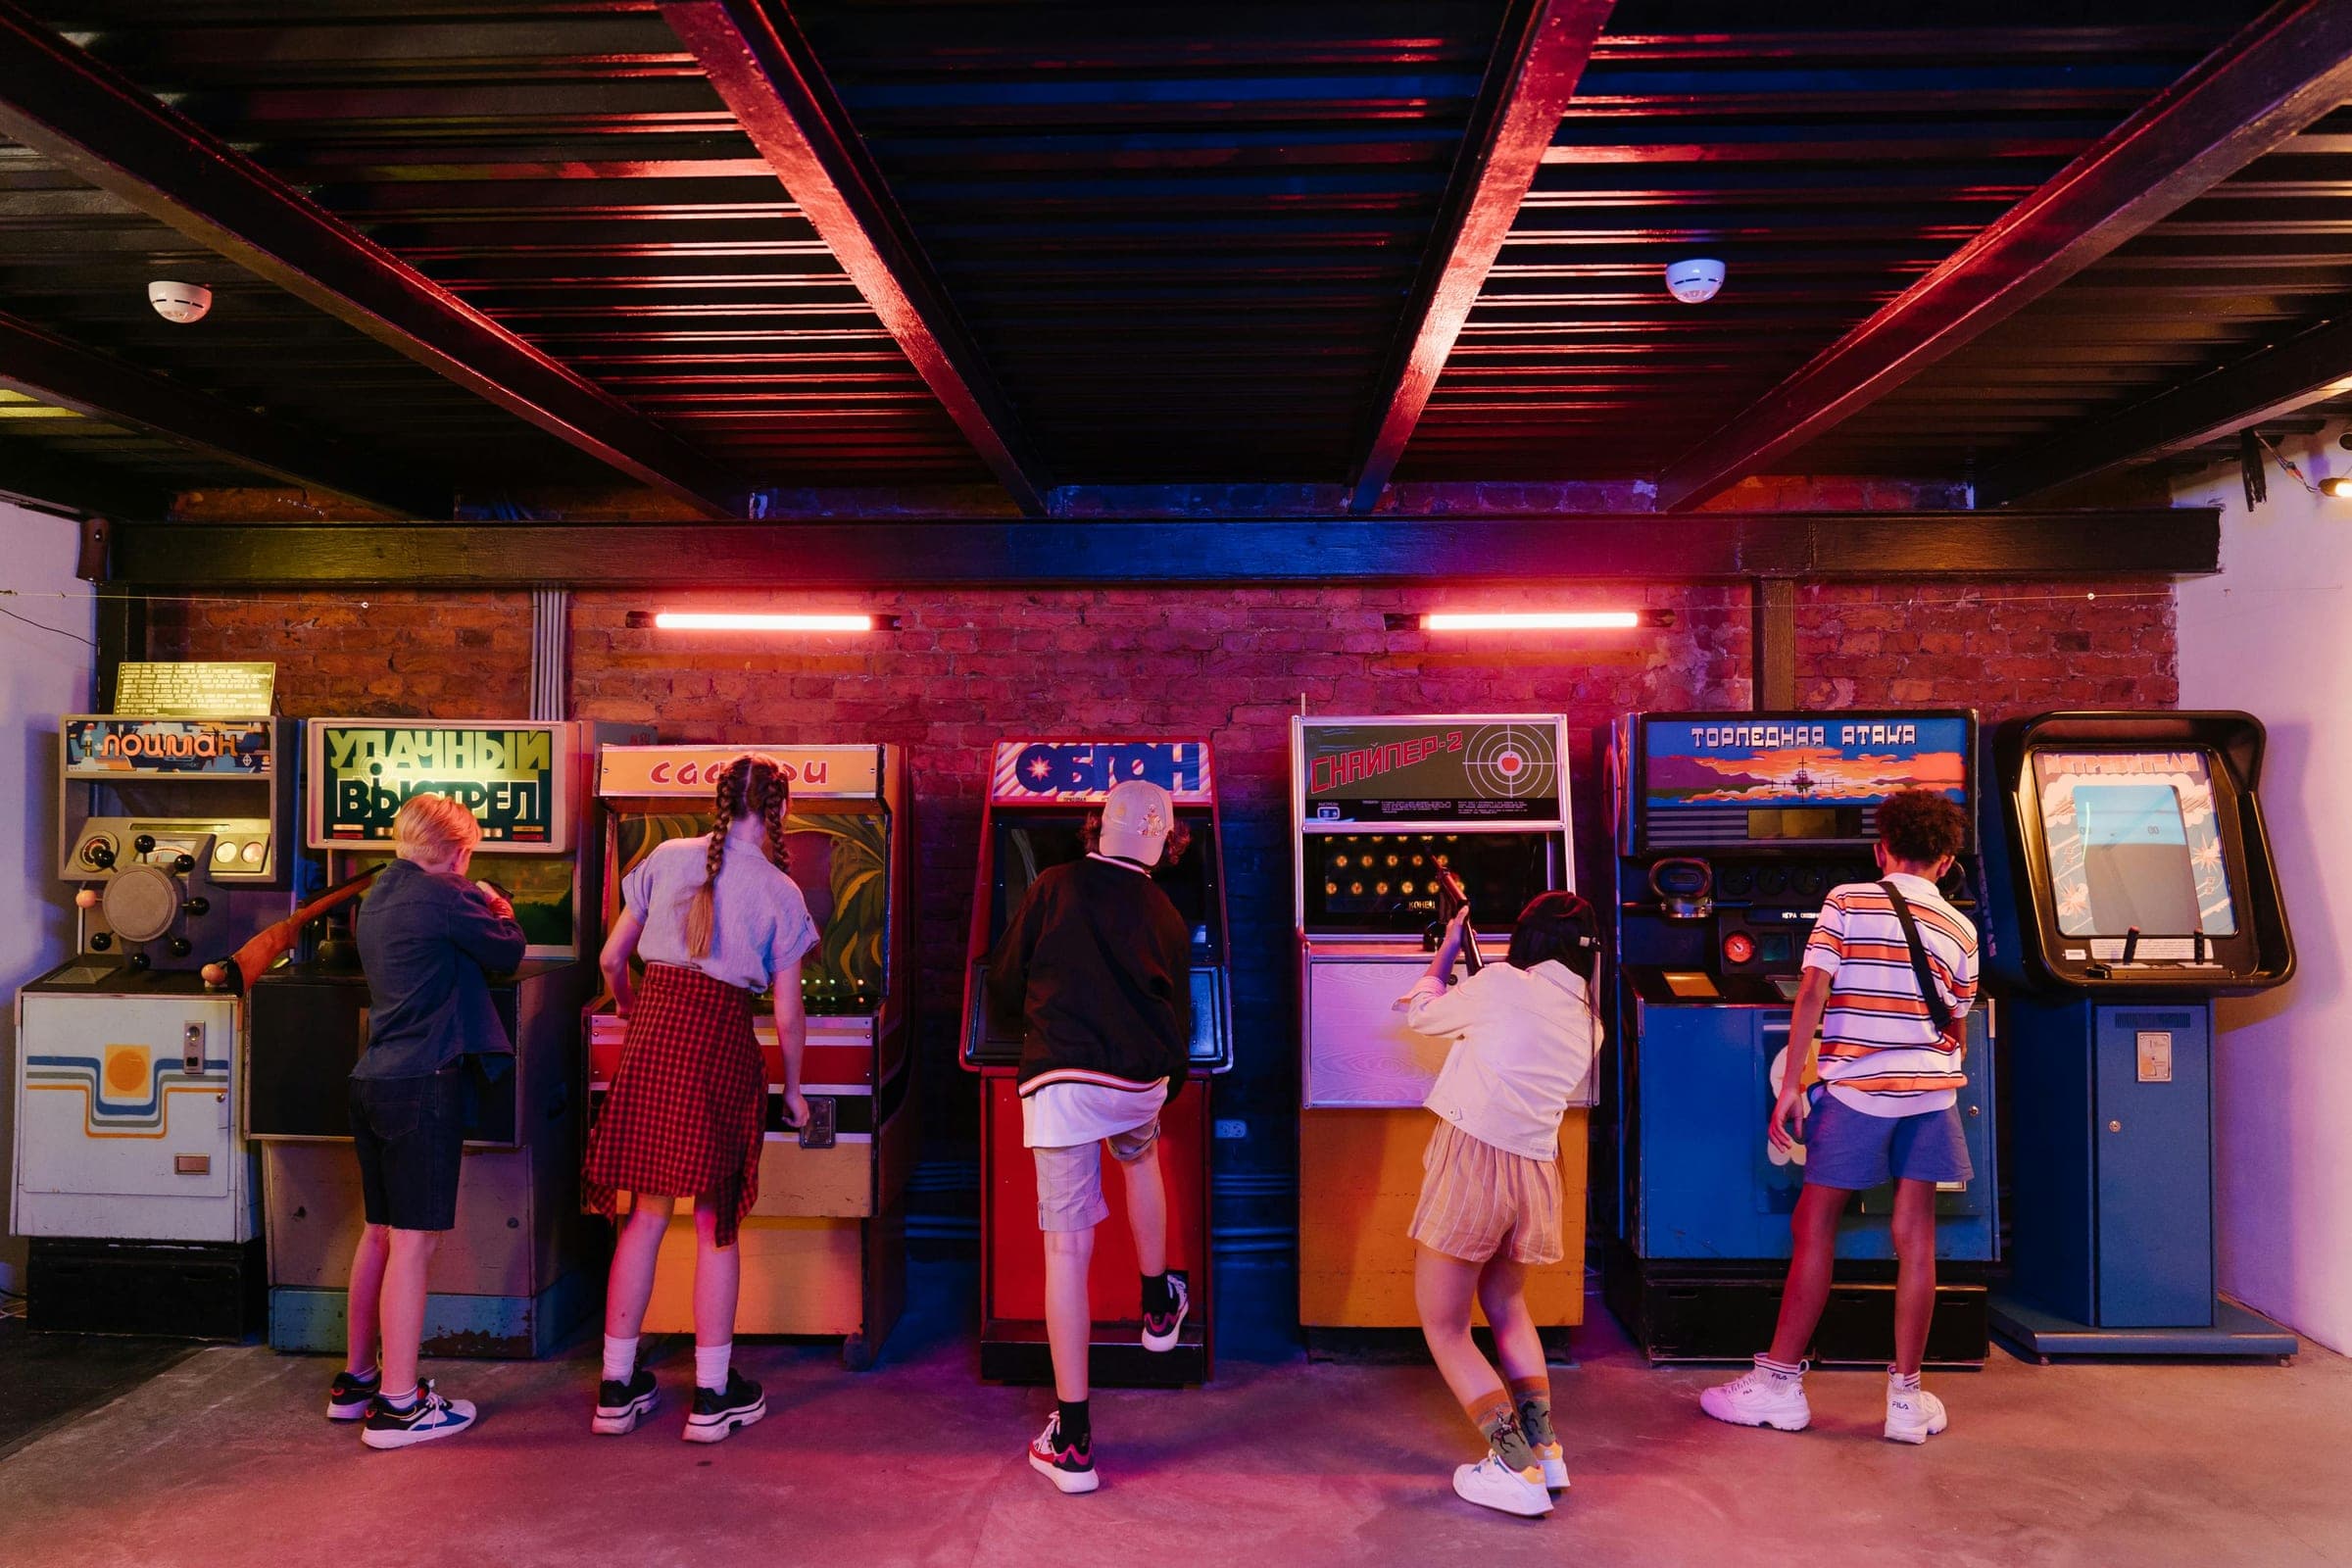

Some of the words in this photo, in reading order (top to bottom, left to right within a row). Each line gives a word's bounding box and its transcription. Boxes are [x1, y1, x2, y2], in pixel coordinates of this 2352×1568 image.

[326, 730, 550, 770] УДАЧНЫЙ
[1690, 726, 1826, 749] ТОРПЕДНАЯ
[1841, 724, 1916, 747] АТАКА
[1015, 743, 1200, 793] ОБГОН
[1309, 730, 1463, 795] СНАЙПЕР-2
[1891, 1400, 1909, 1410] FILA
